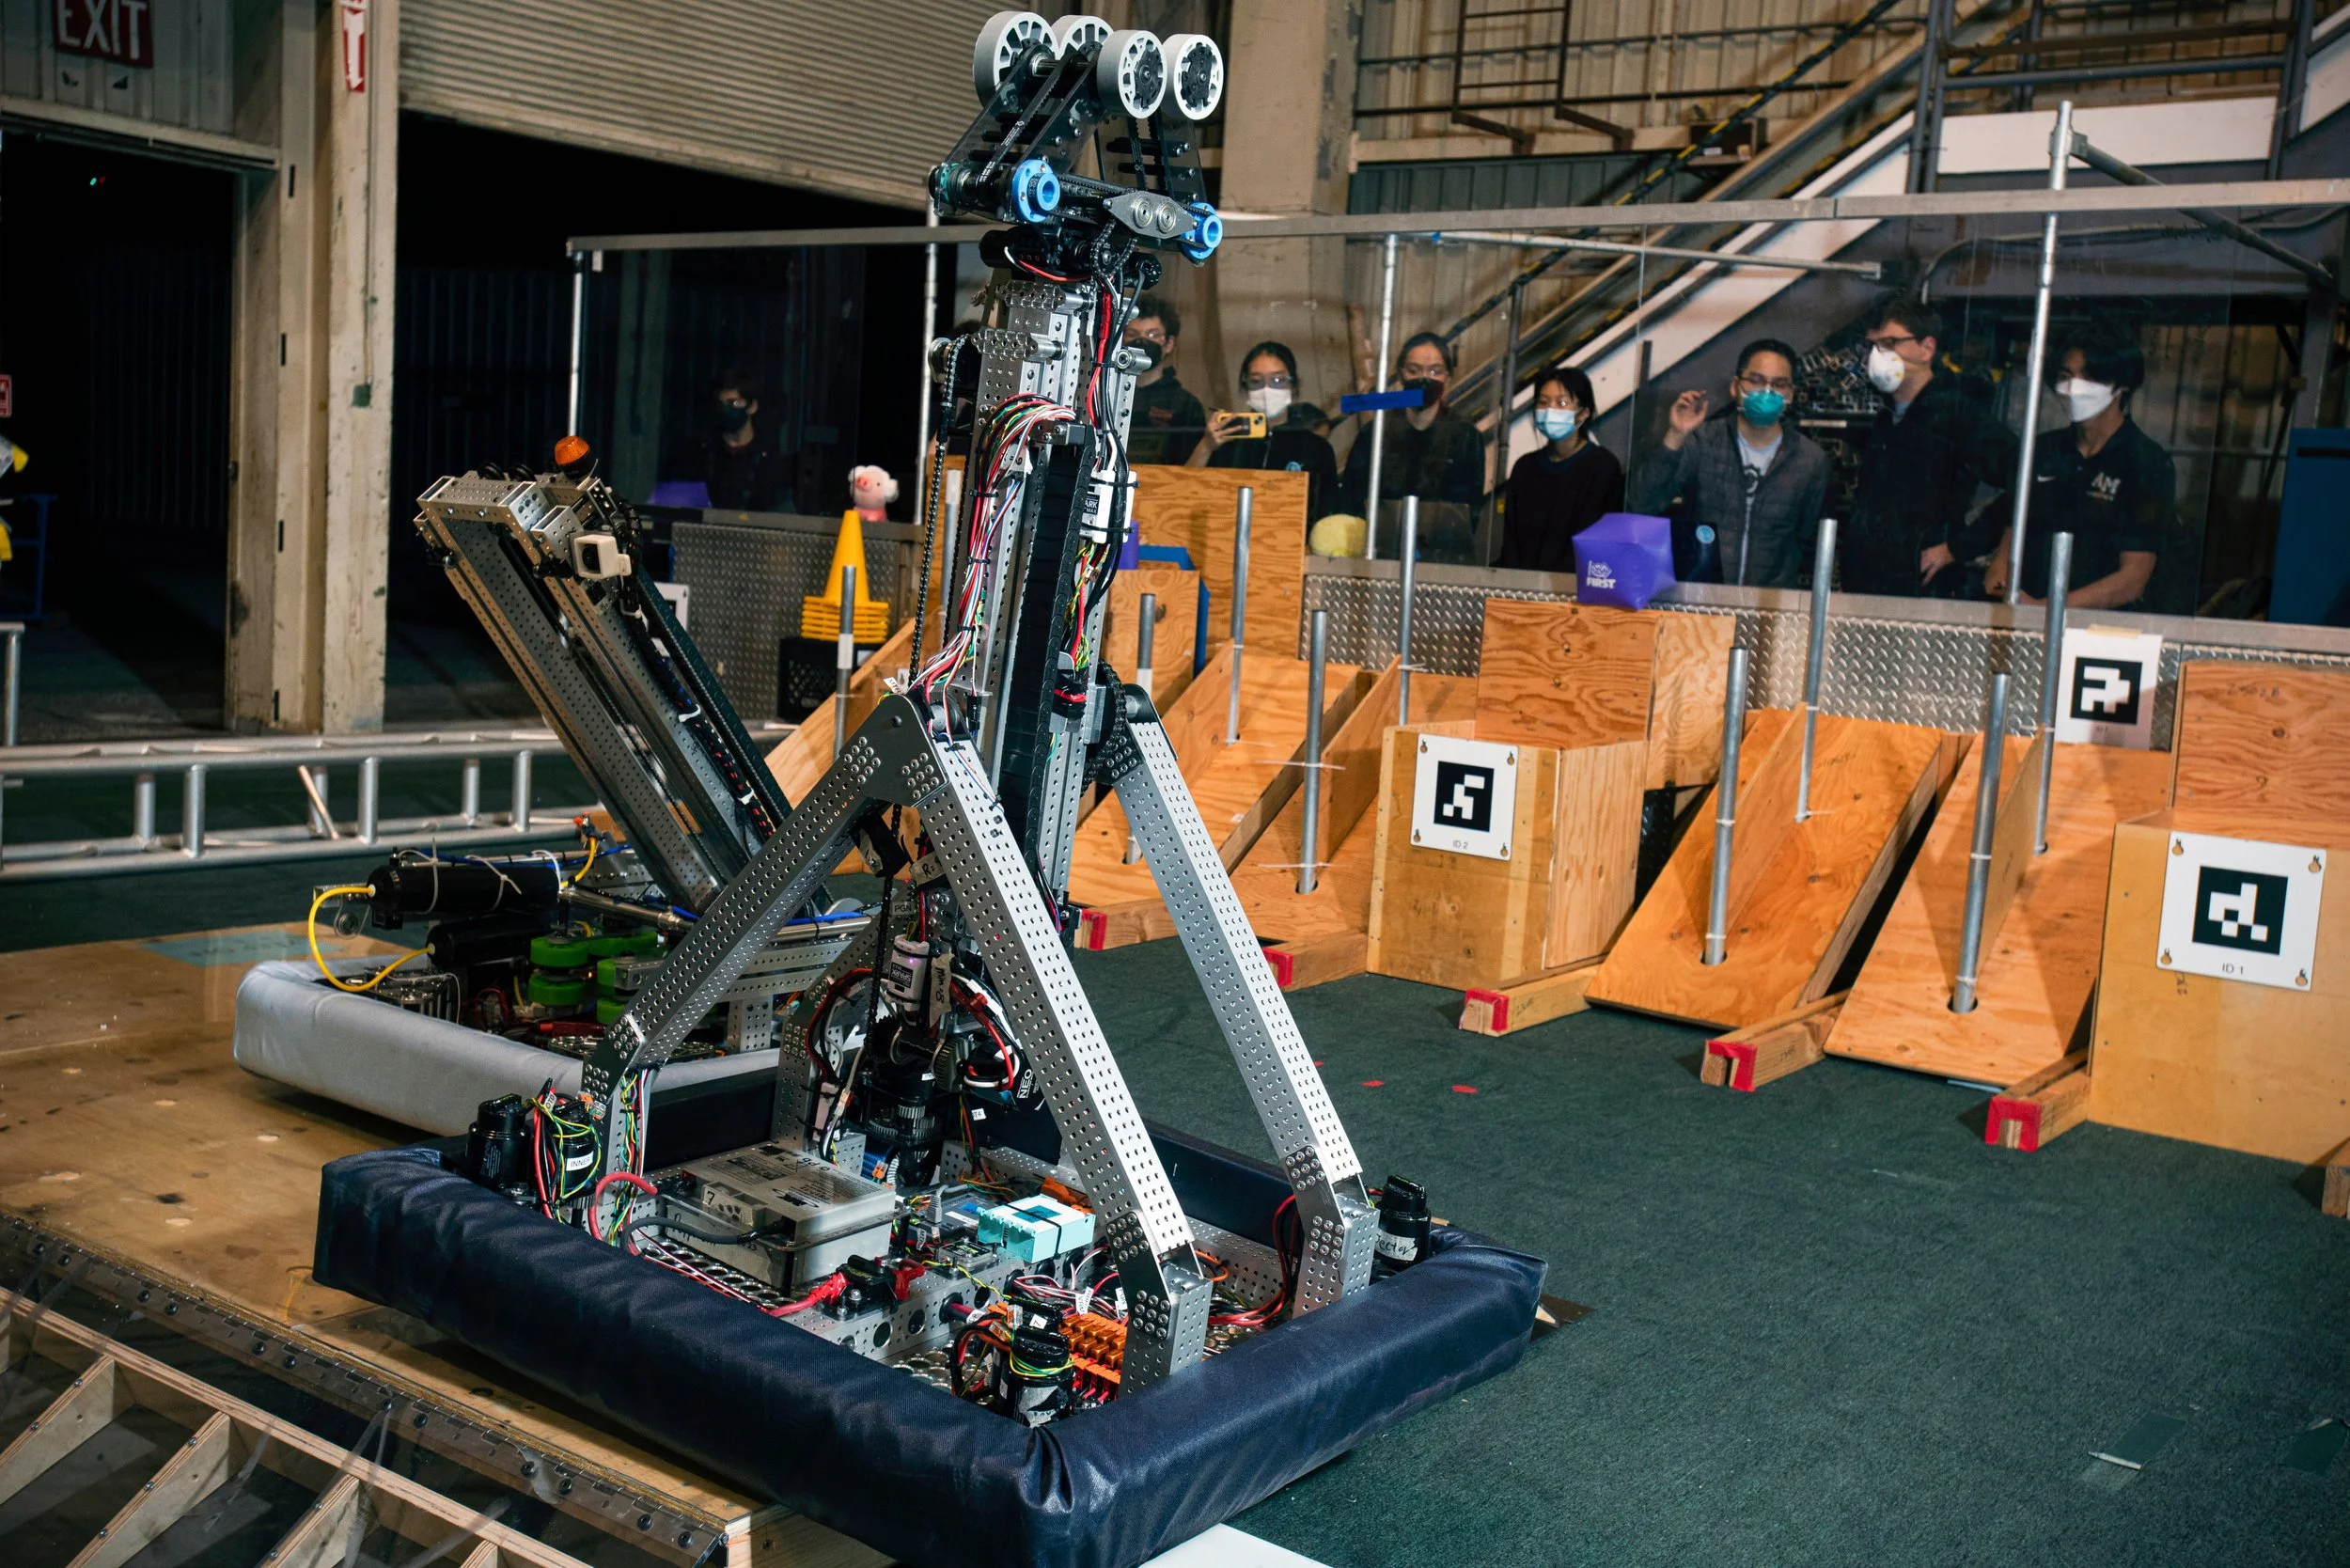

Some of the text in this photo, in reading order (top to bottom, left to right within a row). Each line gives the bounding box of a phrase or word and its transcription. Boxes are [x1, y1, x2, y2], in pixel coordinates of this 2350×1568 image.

[57, 0, 148, 60] EXIT
[1586, 576, 1616, 589] FIRST
[1453, 839, 1469, 850] ID 2
[2221, 963, 2245, 976] ID 1
[1018, 1069, 1032, 1098] NEO
[570, 1157, 591, 1168] INNER
